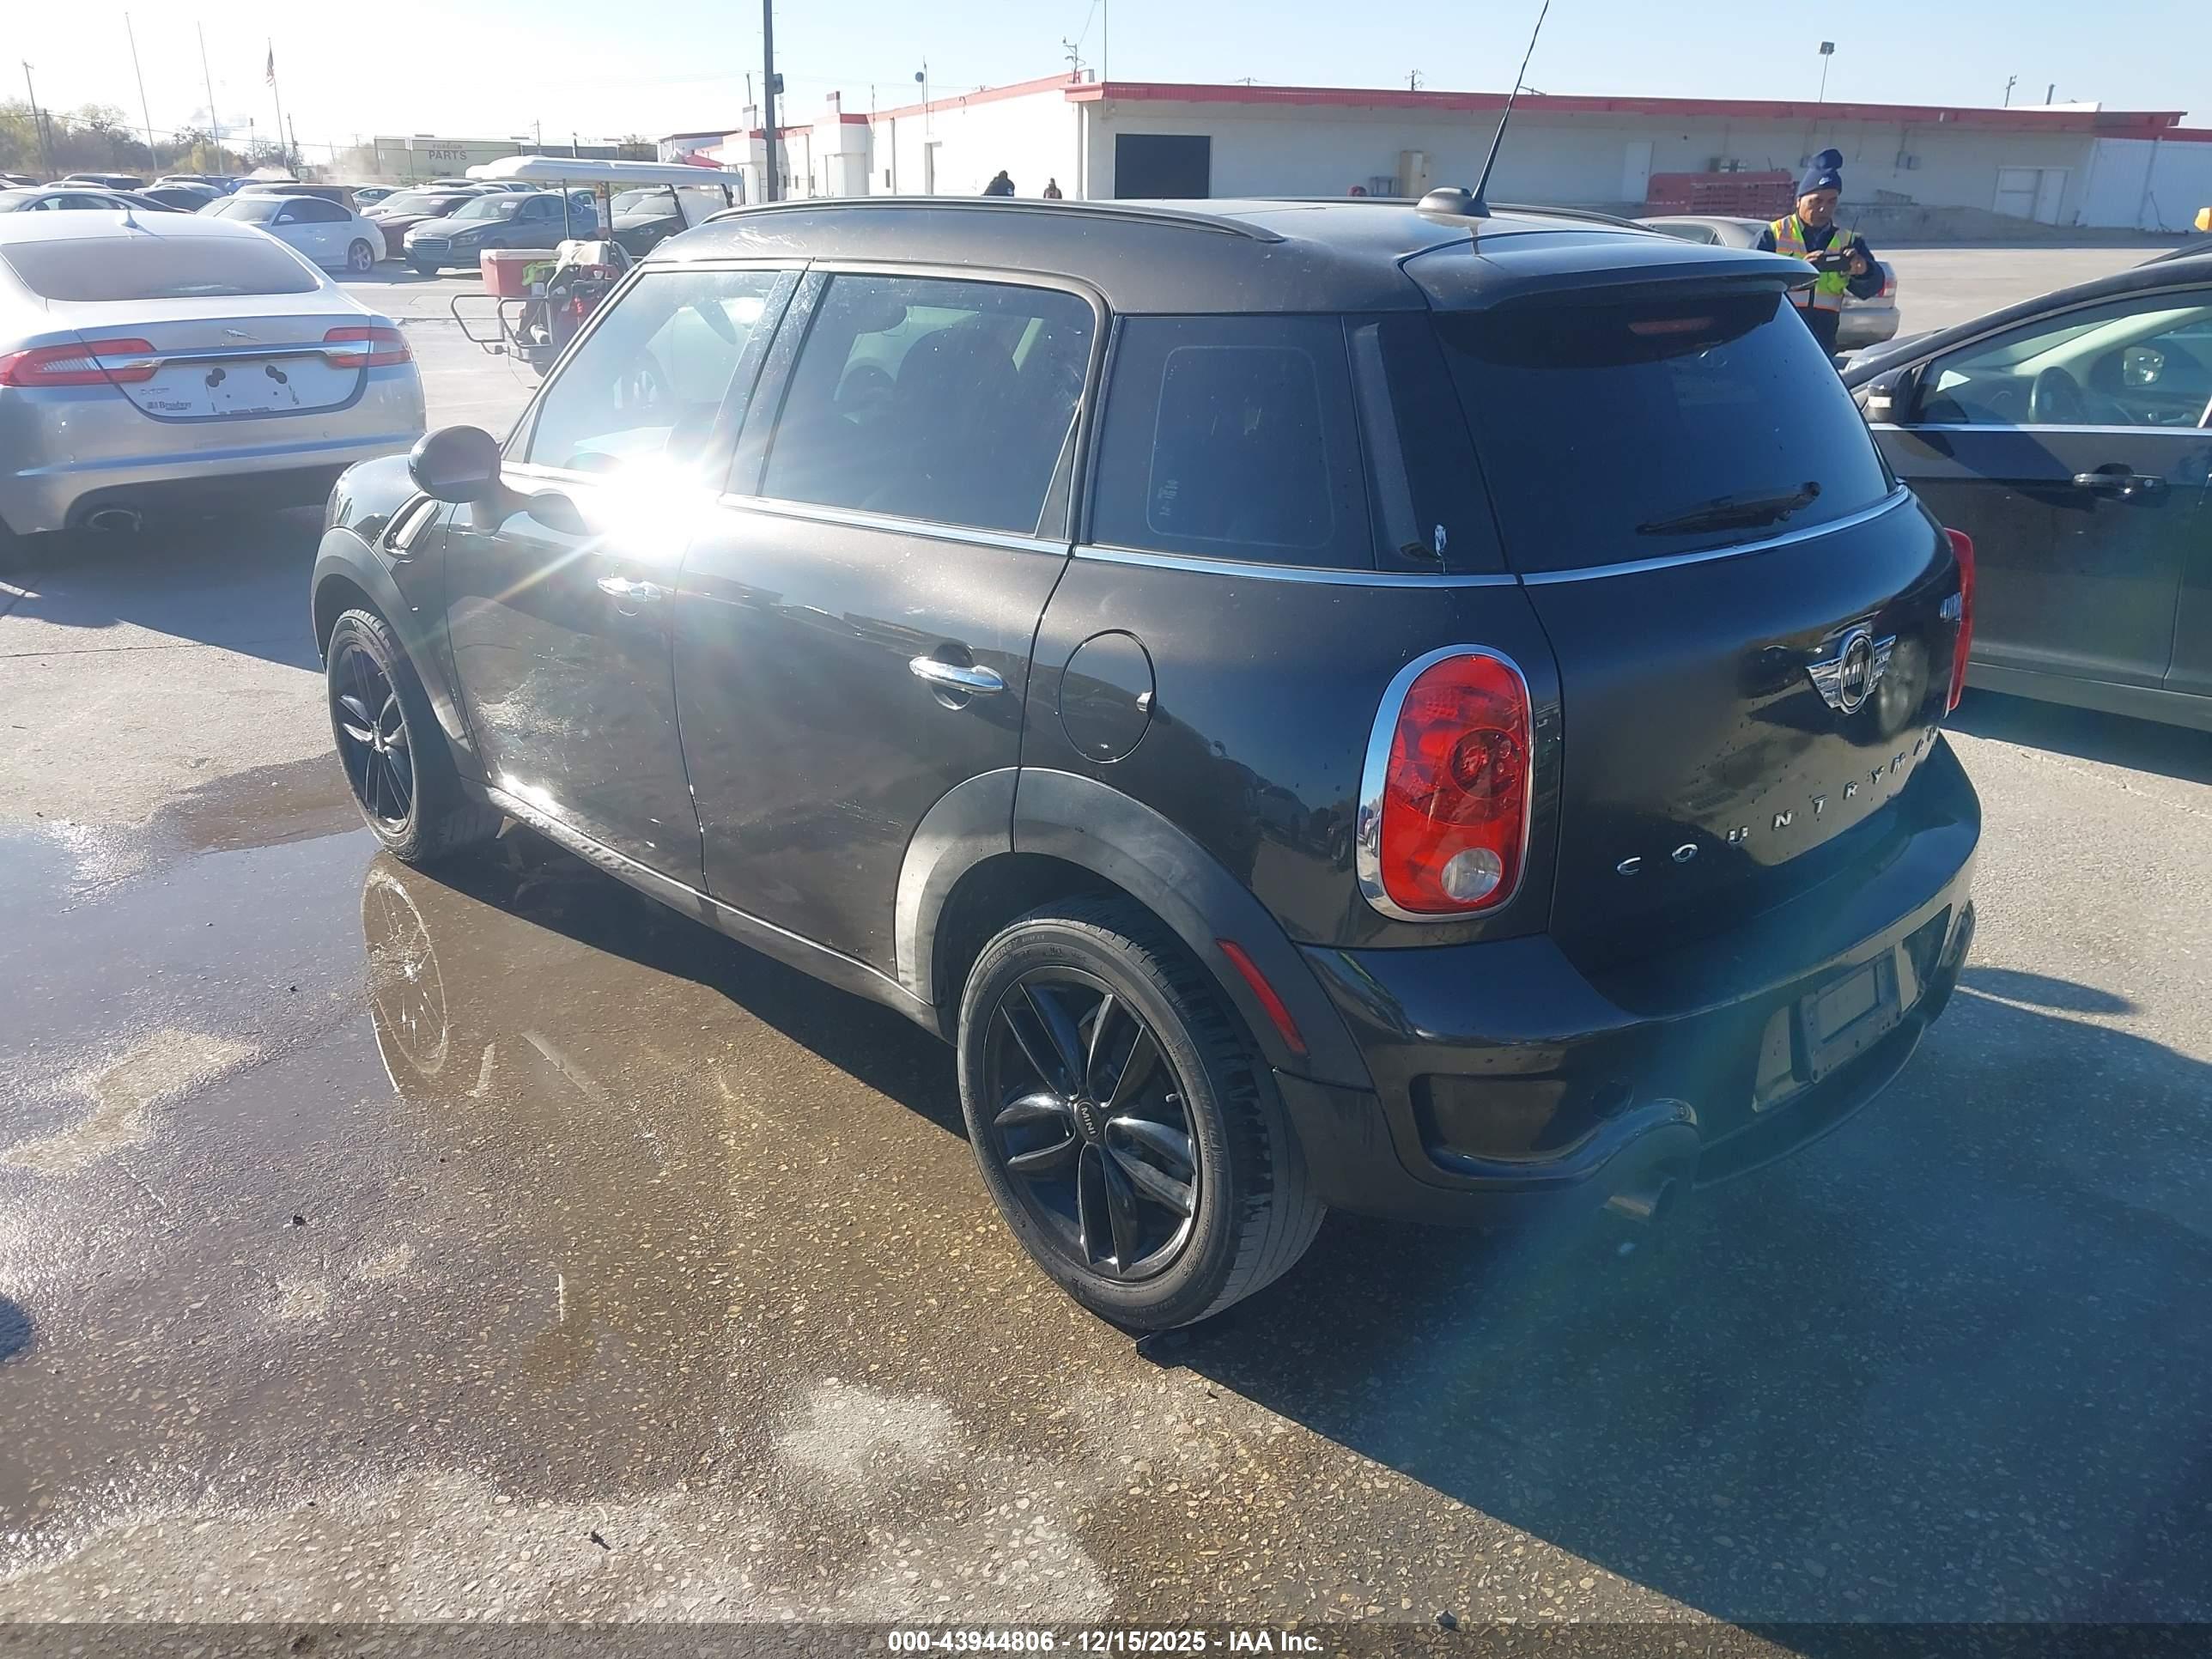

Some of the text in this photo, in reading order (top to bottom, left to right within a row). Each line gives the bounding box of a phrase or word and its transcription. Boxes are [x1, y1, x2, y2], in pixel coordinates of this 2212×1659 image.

[428, 150, 468, 161] PARTS
[1844, 659, 1871, 688] MINI
[1080, 1107, 1097, 1134] MINI
